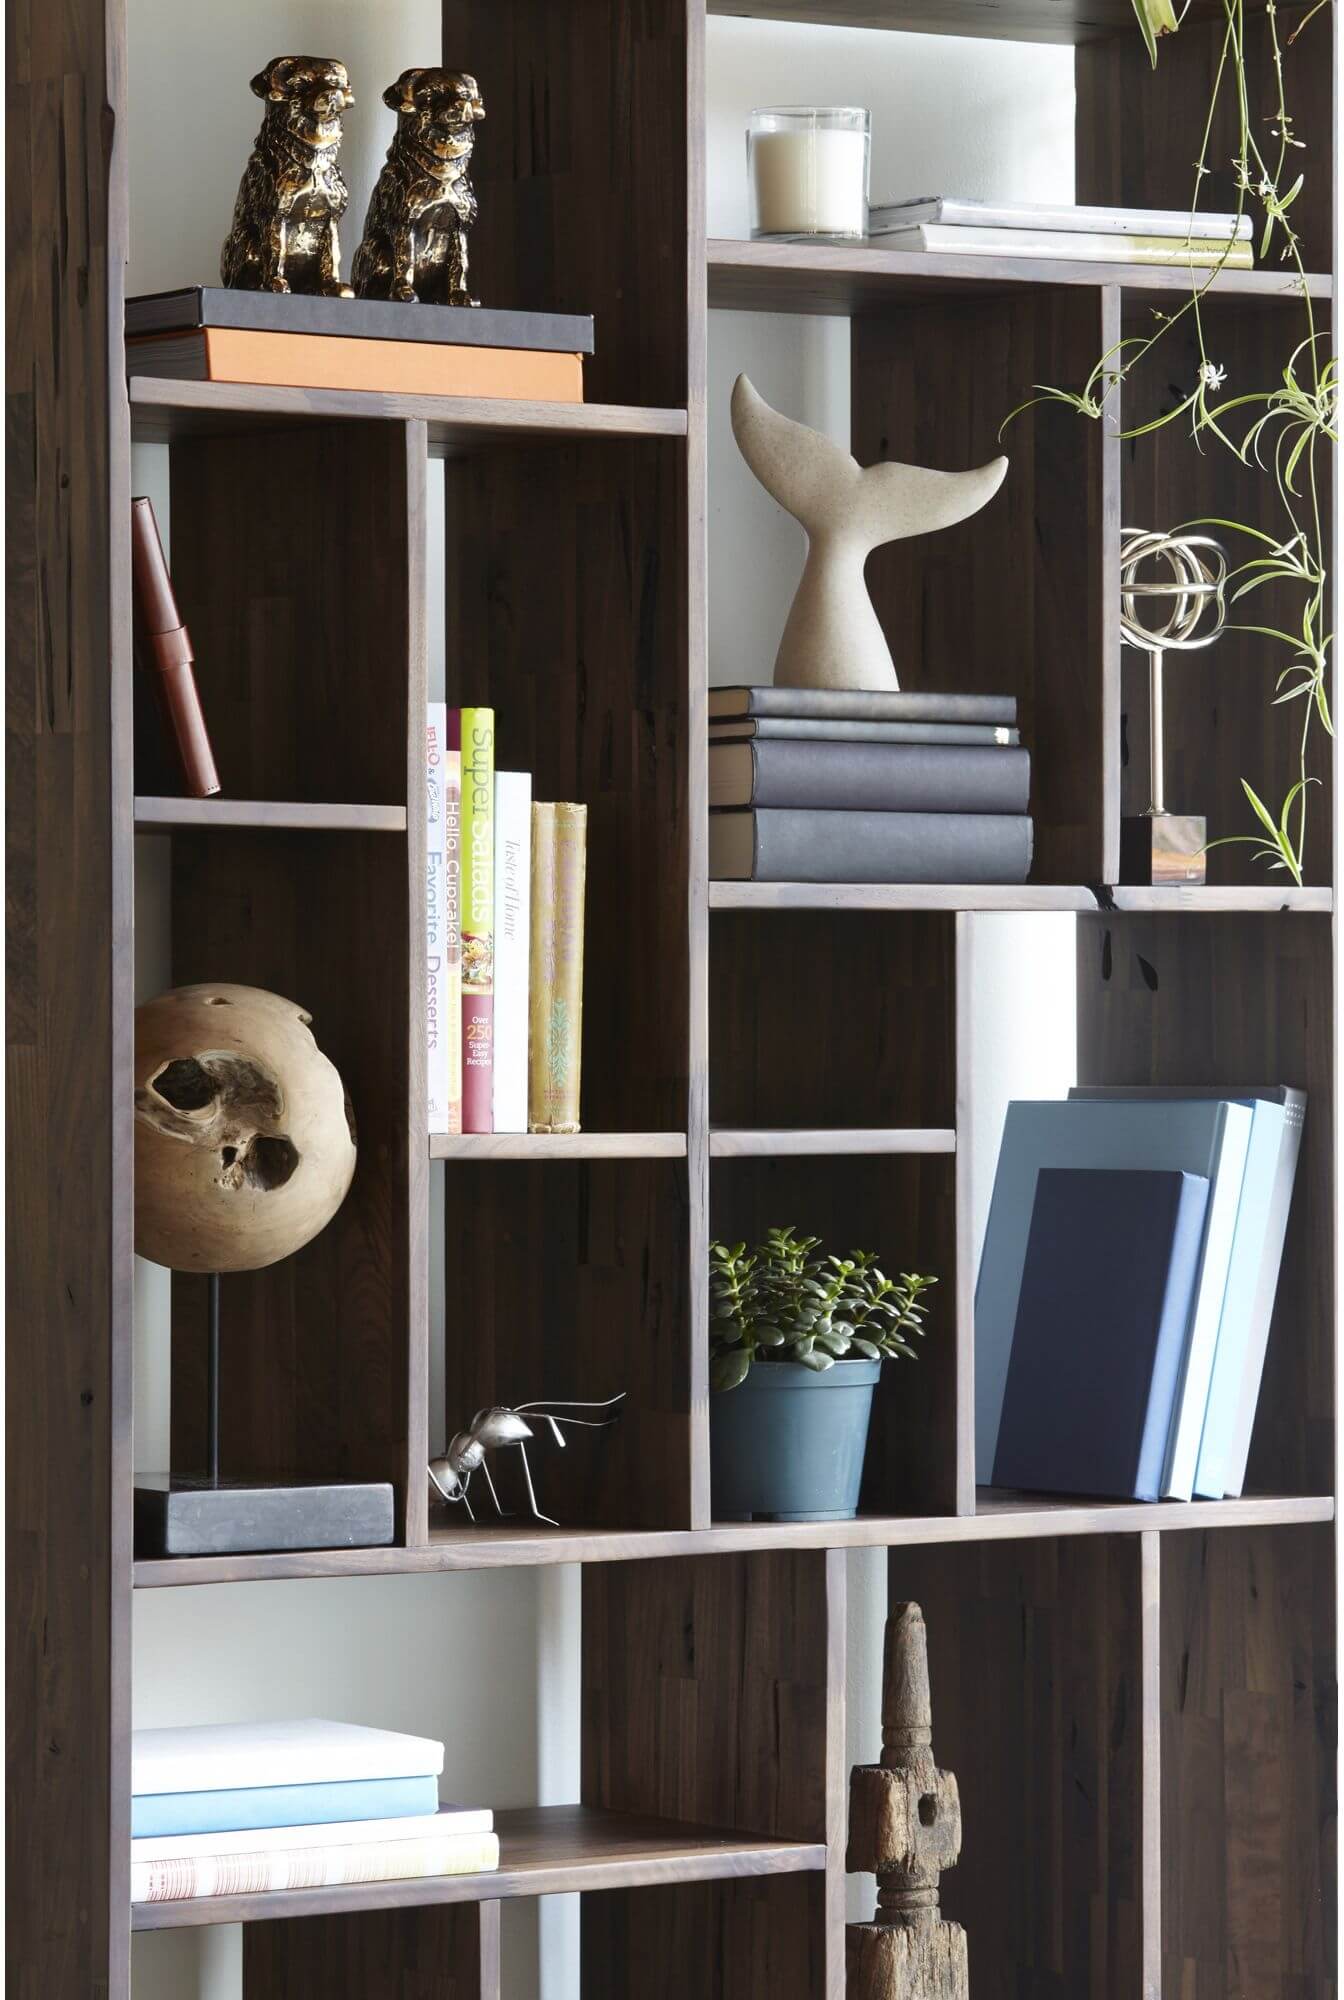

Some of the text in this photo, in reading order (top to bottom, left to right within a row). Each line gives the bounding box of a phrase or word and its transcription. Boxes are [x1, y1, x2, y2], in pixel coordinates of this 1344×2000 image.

[464, 728, 493, 921] Super Salads
[504, 839, 520, 875] Taste
[427, 852, 441, 943] Favorite
[446, 801, 459, 948] Hello, Cupcake!
[503, 893, 519, 941] Home
[427, 956, 441, 1048] Desserts
[467, 1024, 492, 1040] 250
[472, 1016, 488, 1024] Over
